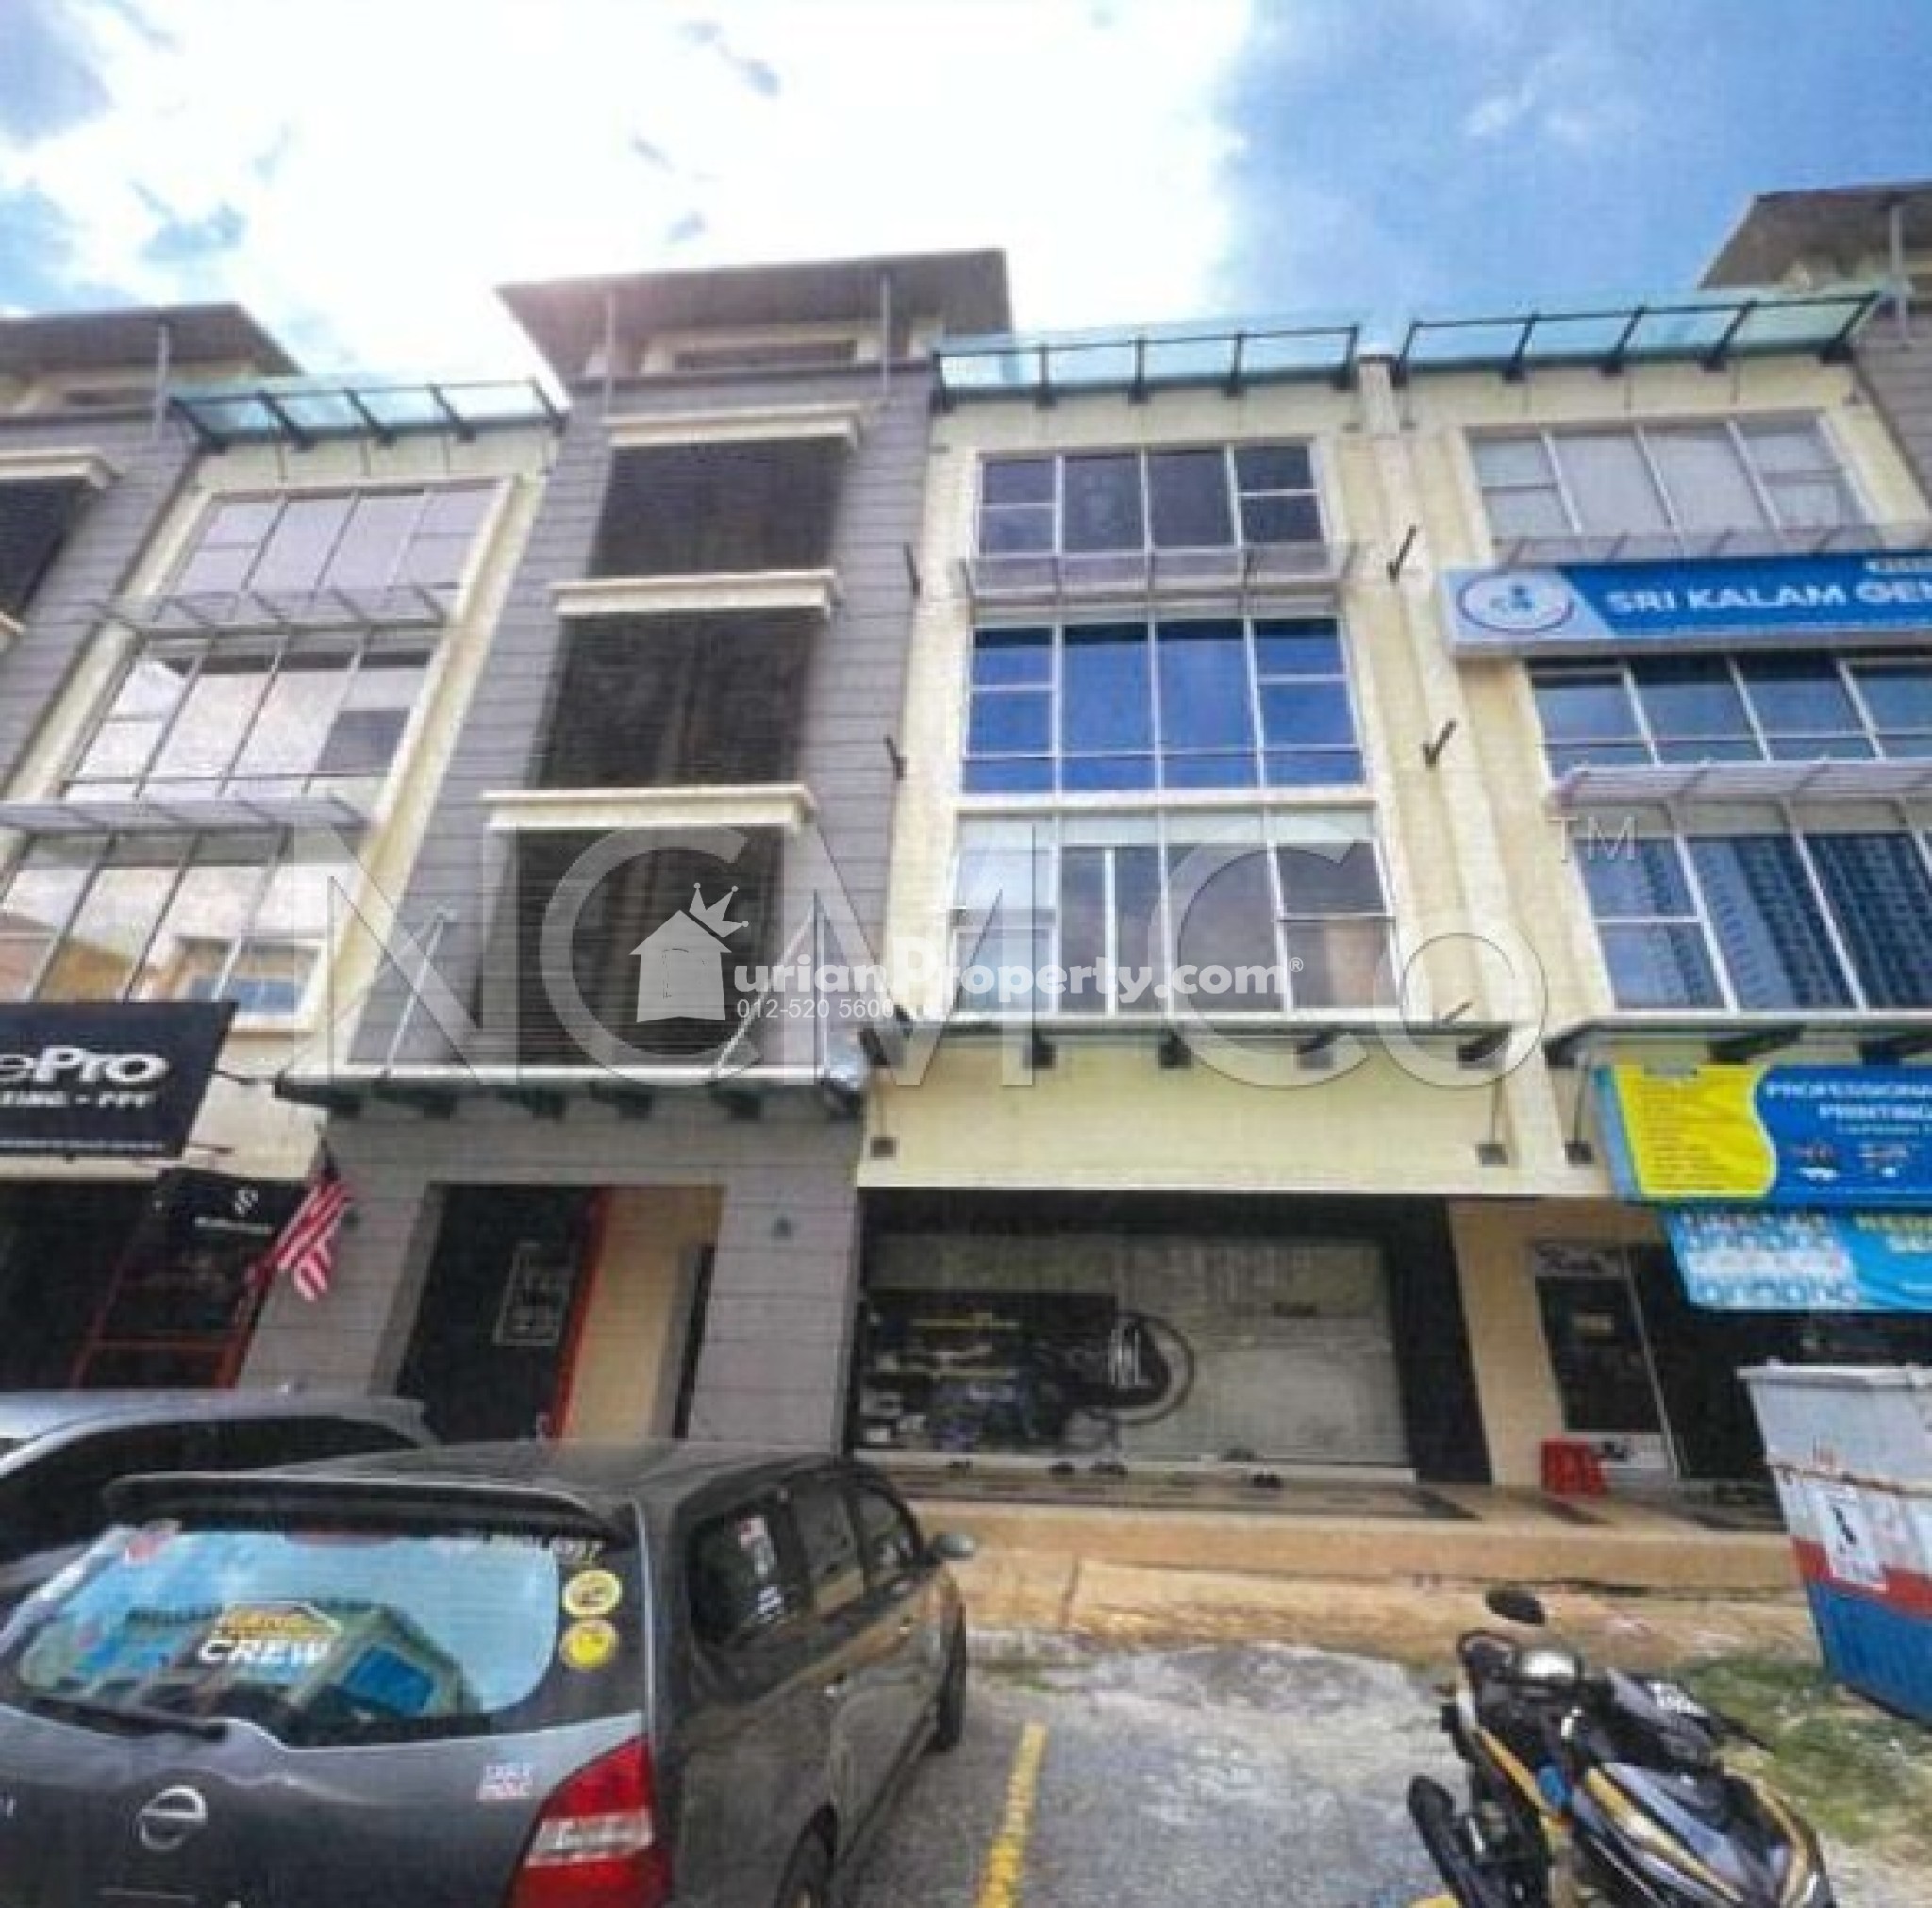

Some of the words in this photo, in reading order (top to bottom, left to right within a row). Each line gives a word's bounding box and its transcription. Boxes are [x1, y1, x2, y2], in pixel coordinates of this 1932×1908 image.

[1607, 591, 1675, 613] SRI
[1688, 584, 1847, 609] KALAM
[198, 1638, 329, 1667] CREW
